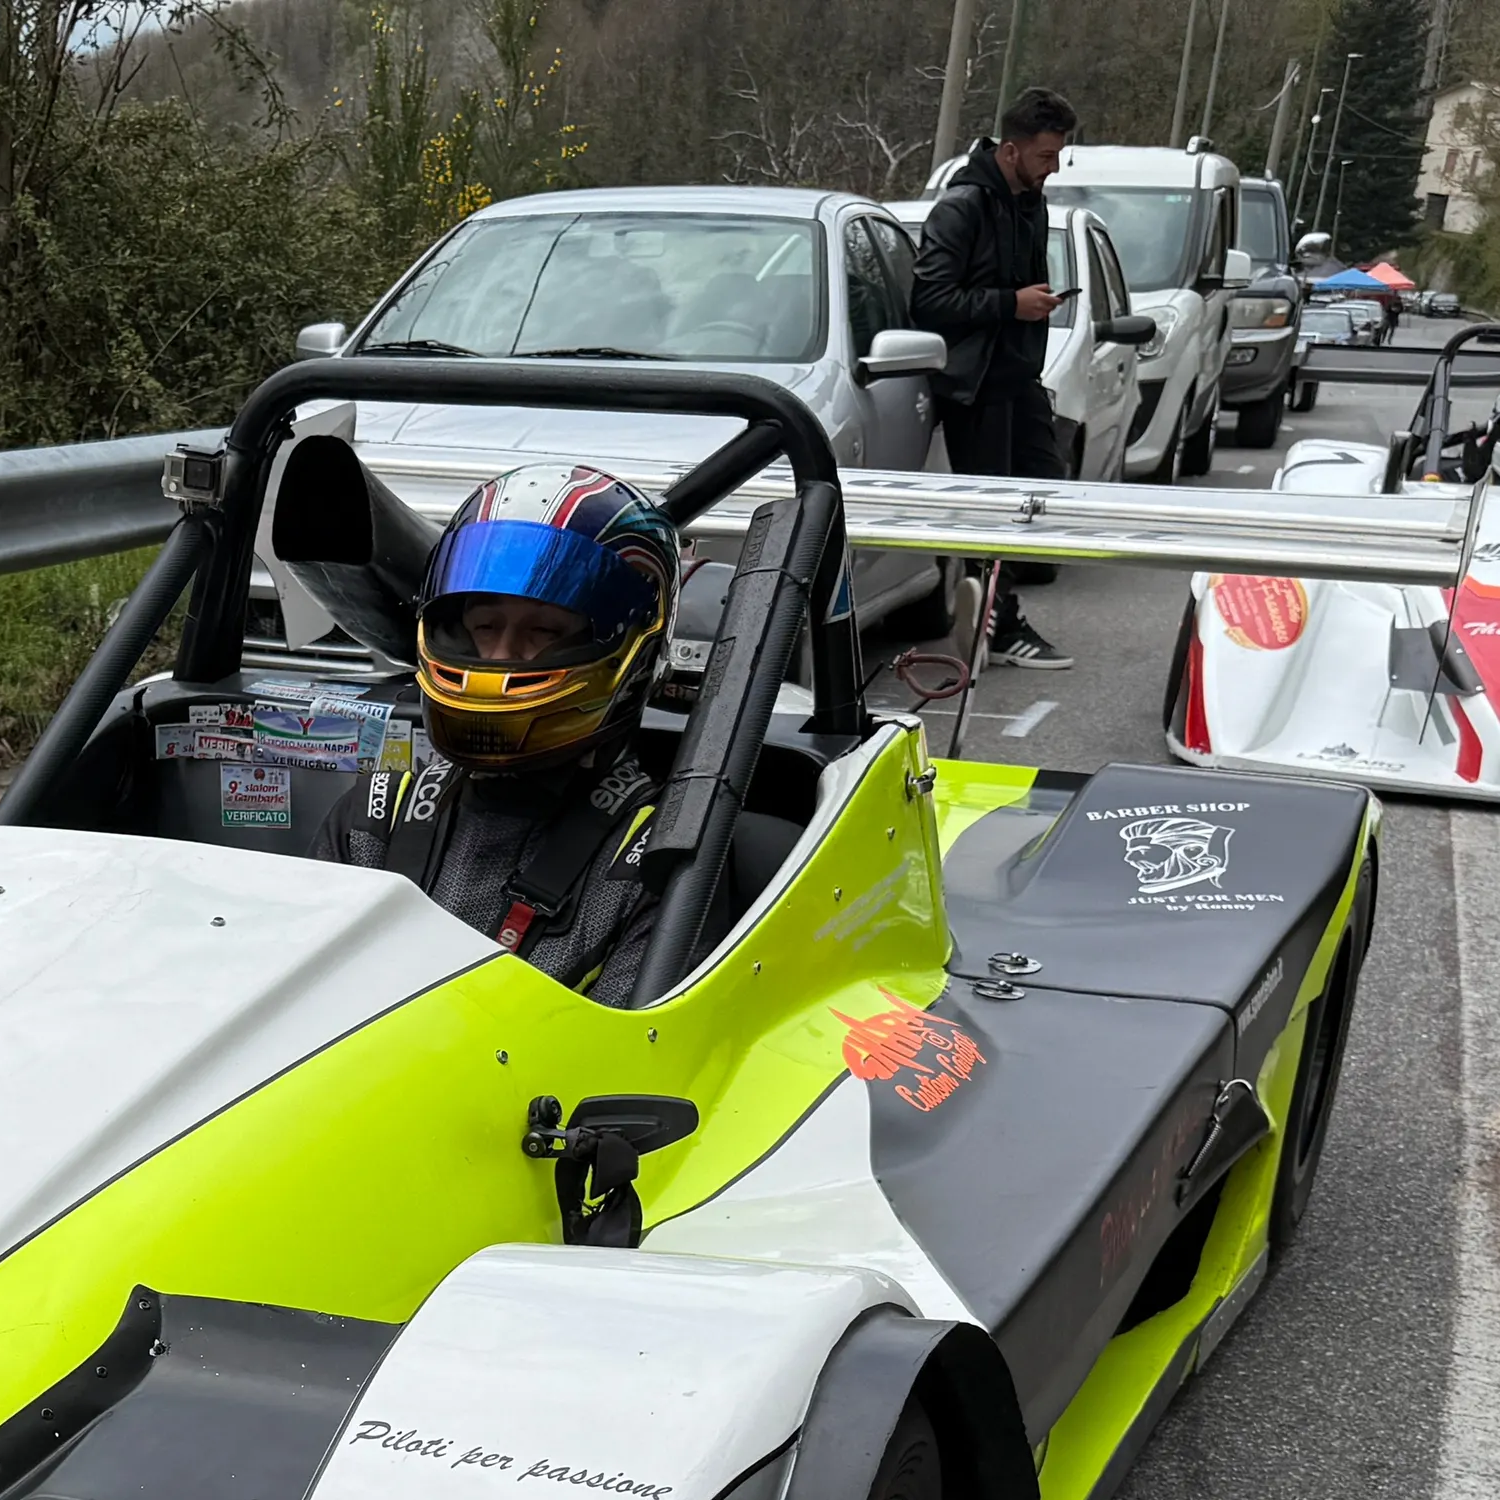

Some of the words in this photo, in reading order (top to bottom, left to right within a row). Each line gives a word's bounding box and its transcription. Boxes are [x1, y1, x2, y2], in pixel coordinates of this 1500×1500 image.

[324, 742, 355, 754] NAPPI
[272, 755, 338, 771] VERIFICATO
[244, 778, 279, 793] slalom
[233, 793, 286, 804] Gambarie
[225, 811, 287, 823] VERIFICATO
[1086, 803, 1182, 821] BARBER
[1186, 802, 1251, 814] SHOP
[1127, 895, 1179, 905] JUST
[1184, 894, 1231, 903] FOR
[1235, 893, 1284, 902] MEN
[1166, 904, 1189, 912] by
[349, 1420, 455, 1458] Piloti
[451, 1446, 514, 1470] per
[516, 1458, 673, 1500] passione
